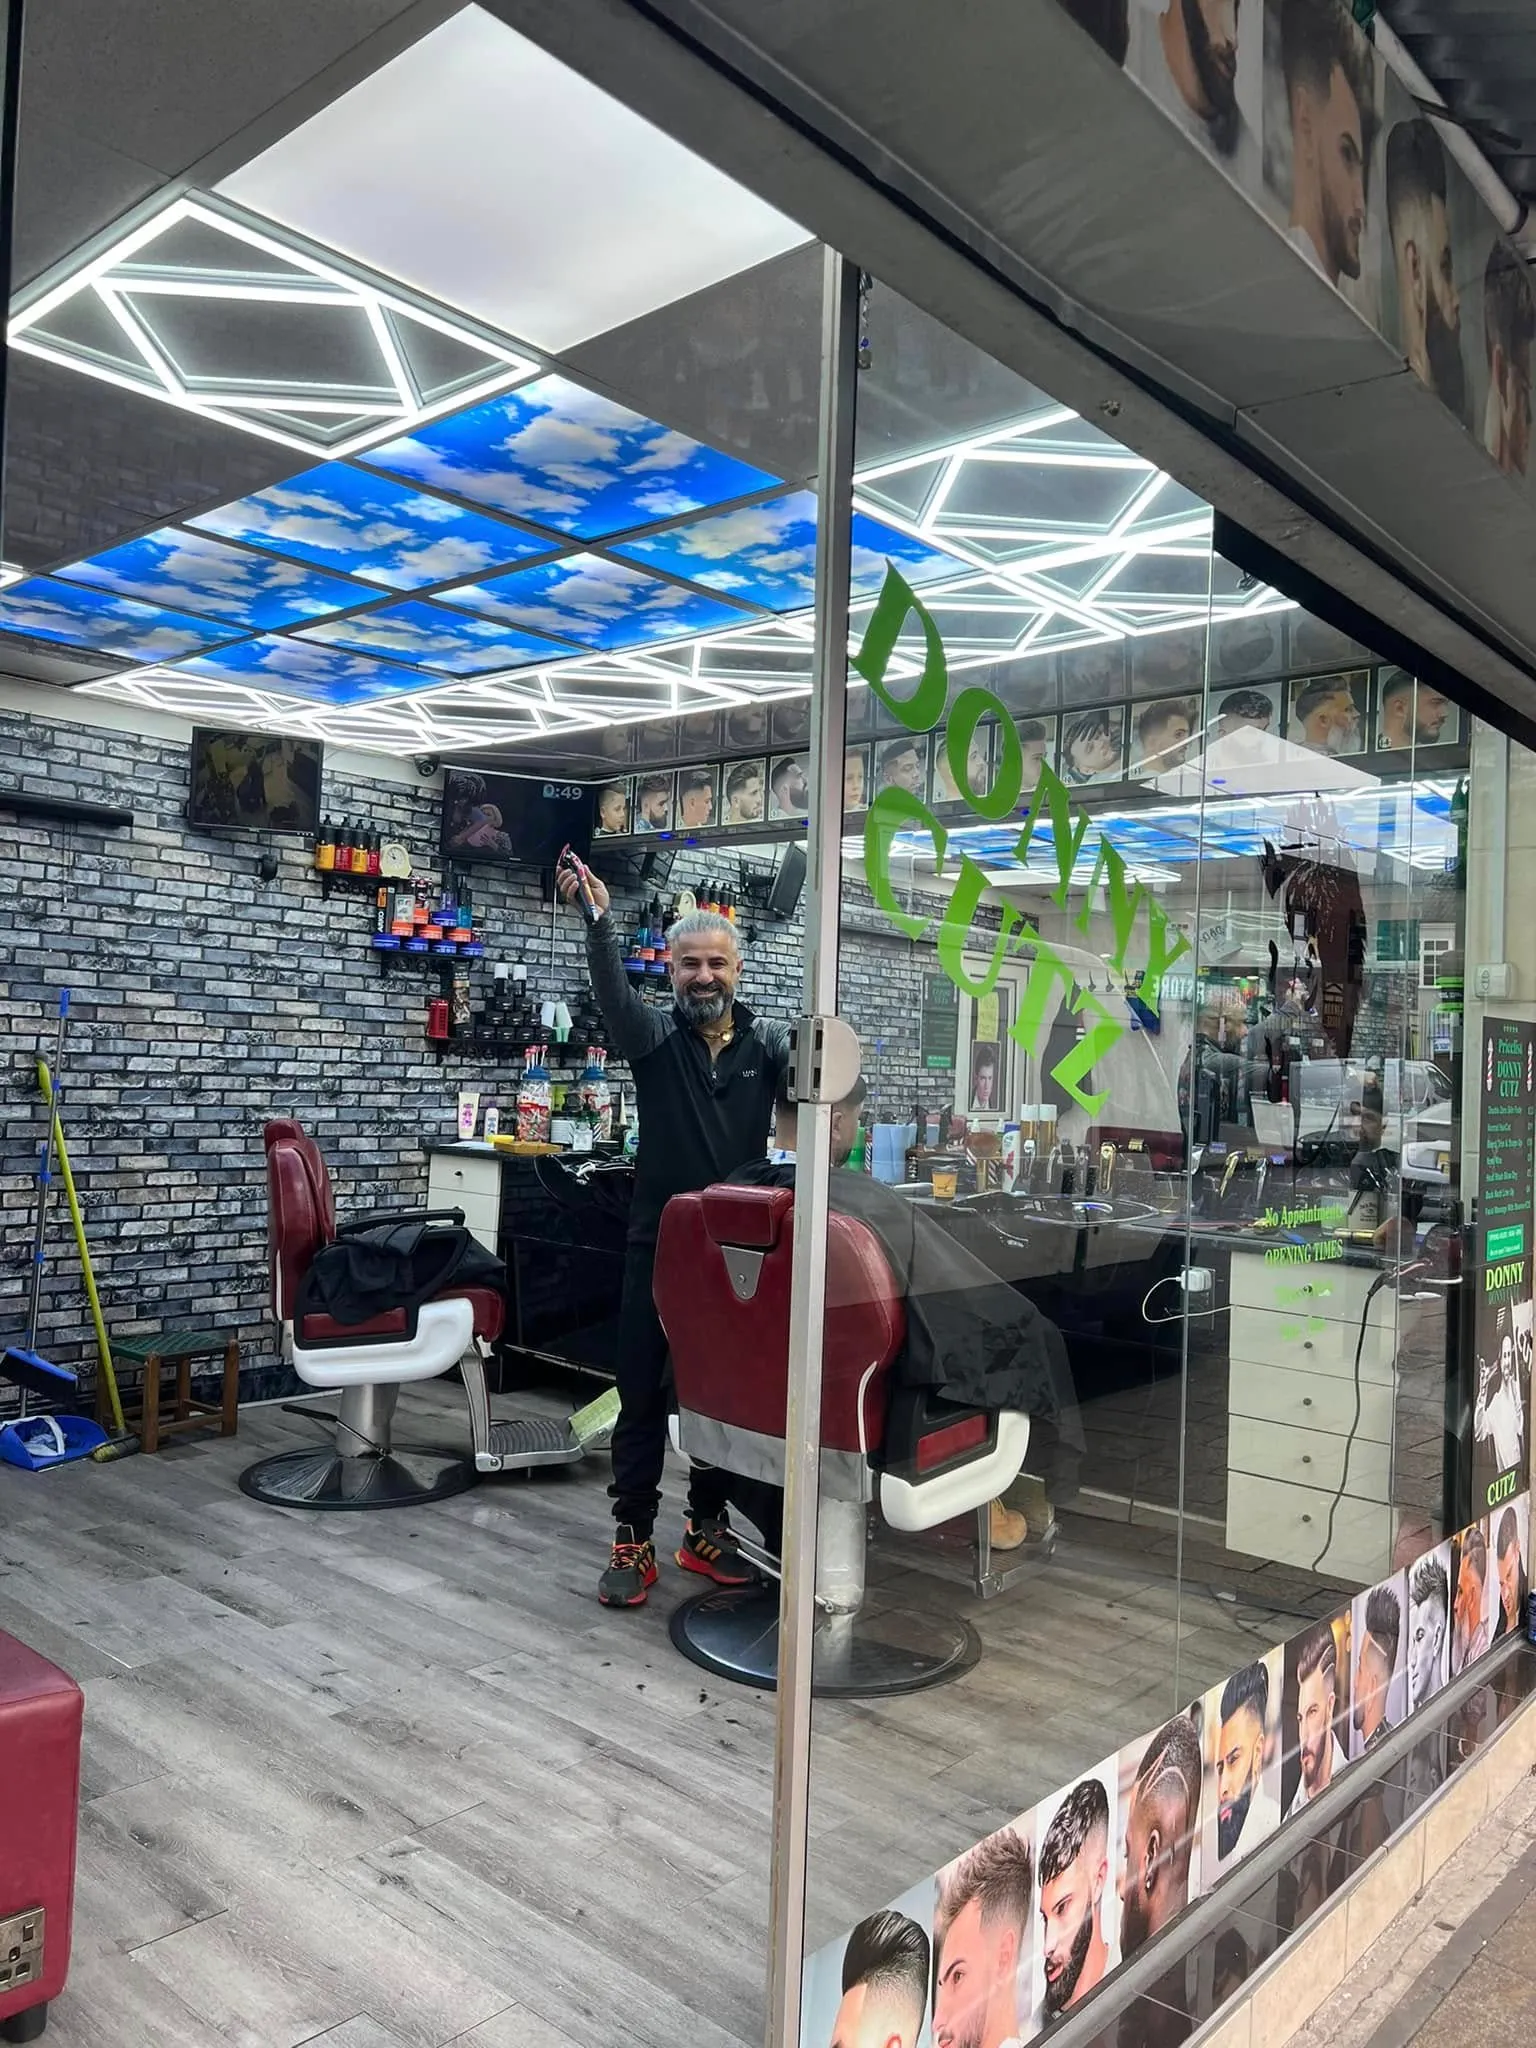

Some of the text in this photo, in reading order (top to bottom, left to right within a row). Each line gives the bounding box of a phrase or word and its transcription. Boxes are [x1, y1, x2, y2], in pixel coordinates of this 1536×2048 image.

[850, 556, 1191, 1015] DONNY
[864, 785, 1124, 1117] CUTZ
[1497, 1061, 1521, 1078] DONNY
[1500, 1080, 1519, 1097] CUTZ
[1264, 1207, 1279, 1228] No
[1264, 1239, 1343, 1266] OPENING TIMES
[1486, 1261, 1525, 1291] DONNY
[1487, 1470, 1516, 1506] CUTZ
